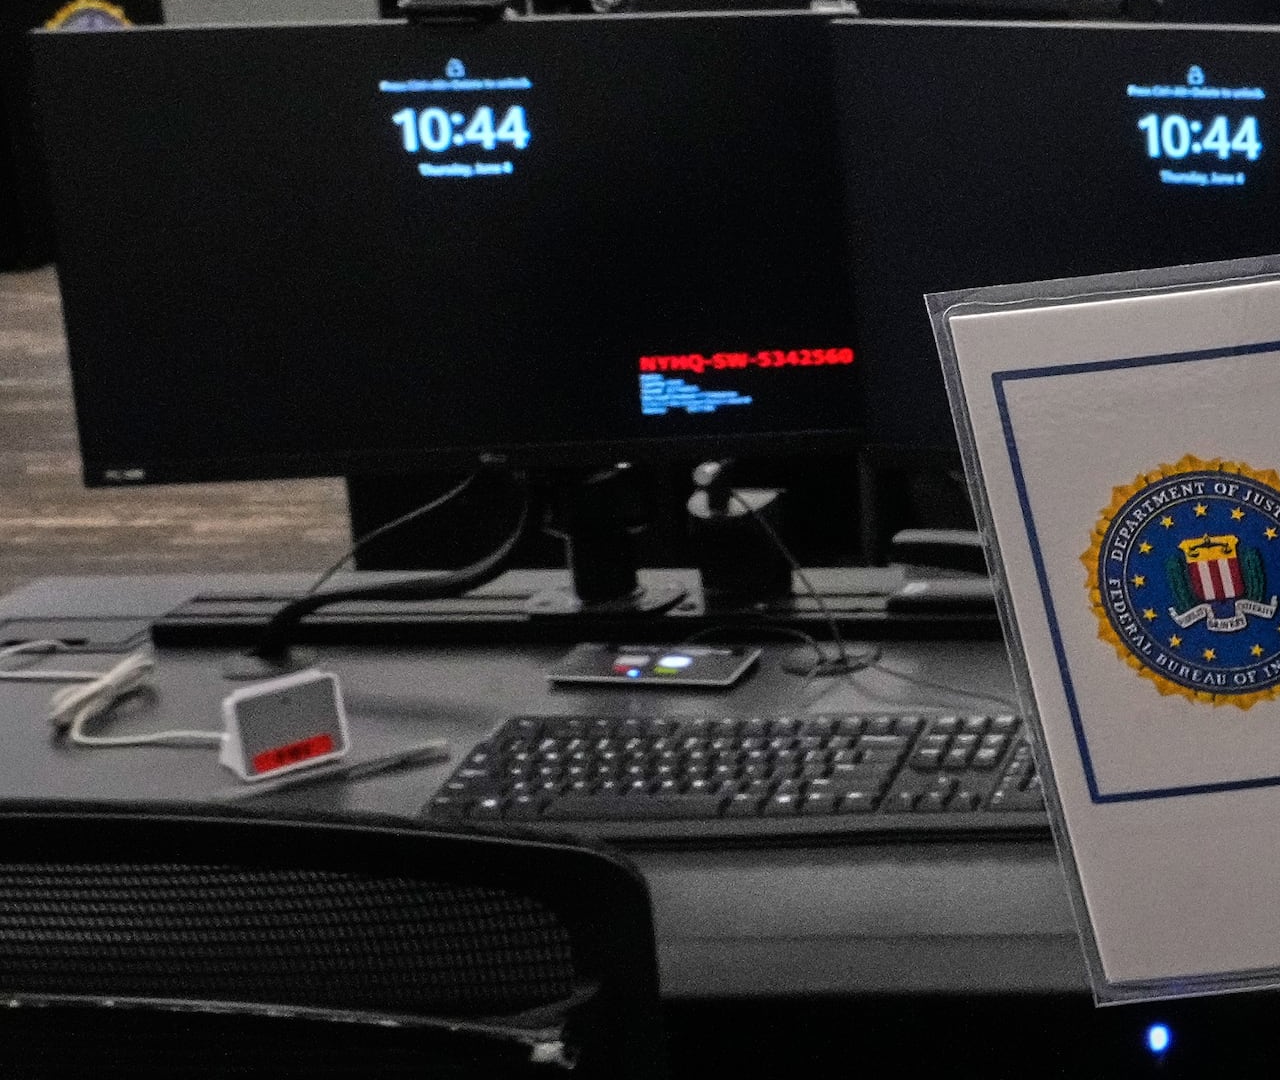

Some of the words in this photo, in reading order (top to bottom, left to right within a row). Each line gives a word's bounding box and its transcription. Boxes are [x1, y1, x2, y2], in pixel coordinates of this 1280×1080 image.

[392, 104, 532, 153] 10:44
[1138, 112, 1264, 161] 10:44
[1111, 481, 1206, 562] DEPARTMENT
[1213, 482, 1240, 498] OF
[1108, 577, 1153, 657] FEDERAL
[1155, 652, 1227, 686] BUREAU
[1232, 670, 1259, 686] OF
